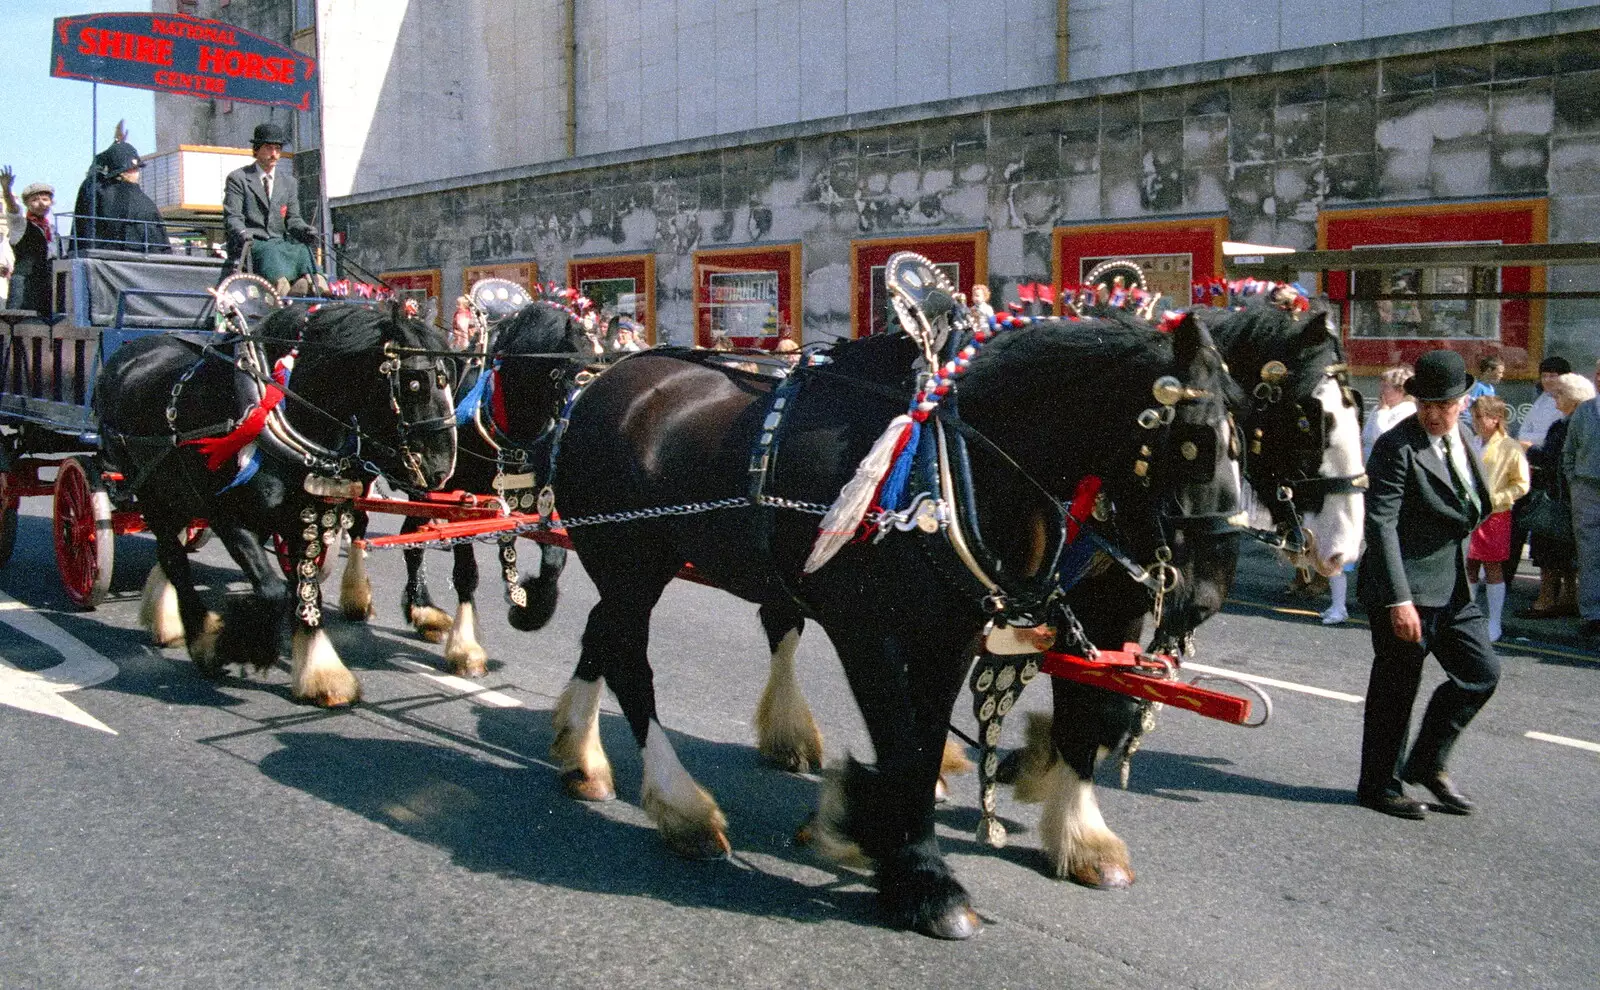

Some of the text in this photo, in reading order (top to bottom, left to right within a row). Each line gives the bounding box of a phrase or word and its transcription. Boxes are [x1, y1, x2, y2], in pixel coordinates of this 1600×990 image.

[152, 19, 239, 47] NATIONAL
[78, 27, 296, 85] SHIRE HORSE
[154, 70, 227, 93] CENTRE
